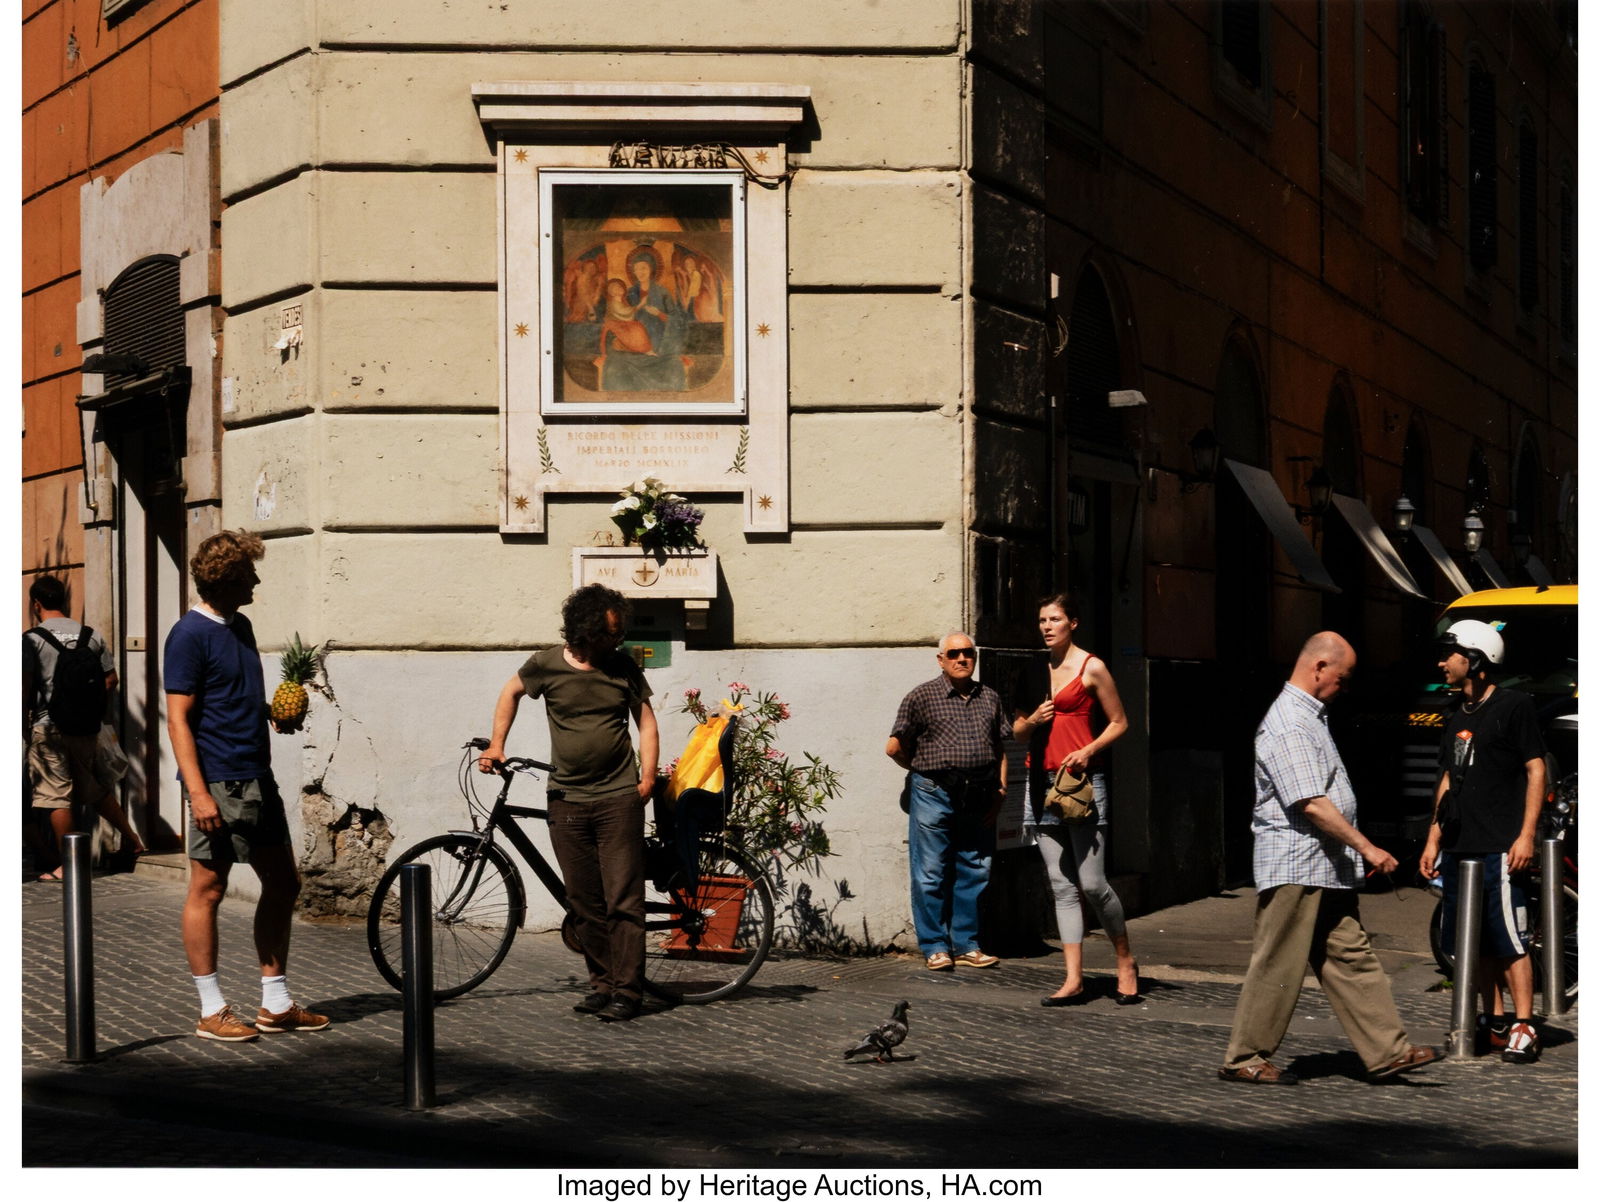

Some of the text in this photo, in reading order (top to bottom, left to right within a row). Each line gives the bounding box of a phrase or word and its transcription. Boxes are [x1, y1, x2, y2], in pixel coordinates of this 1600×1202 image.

[567, 431, 720, 441] RICORDO DELLE MISSIONI
[597, 568, 700, 577] AVE MARIA
